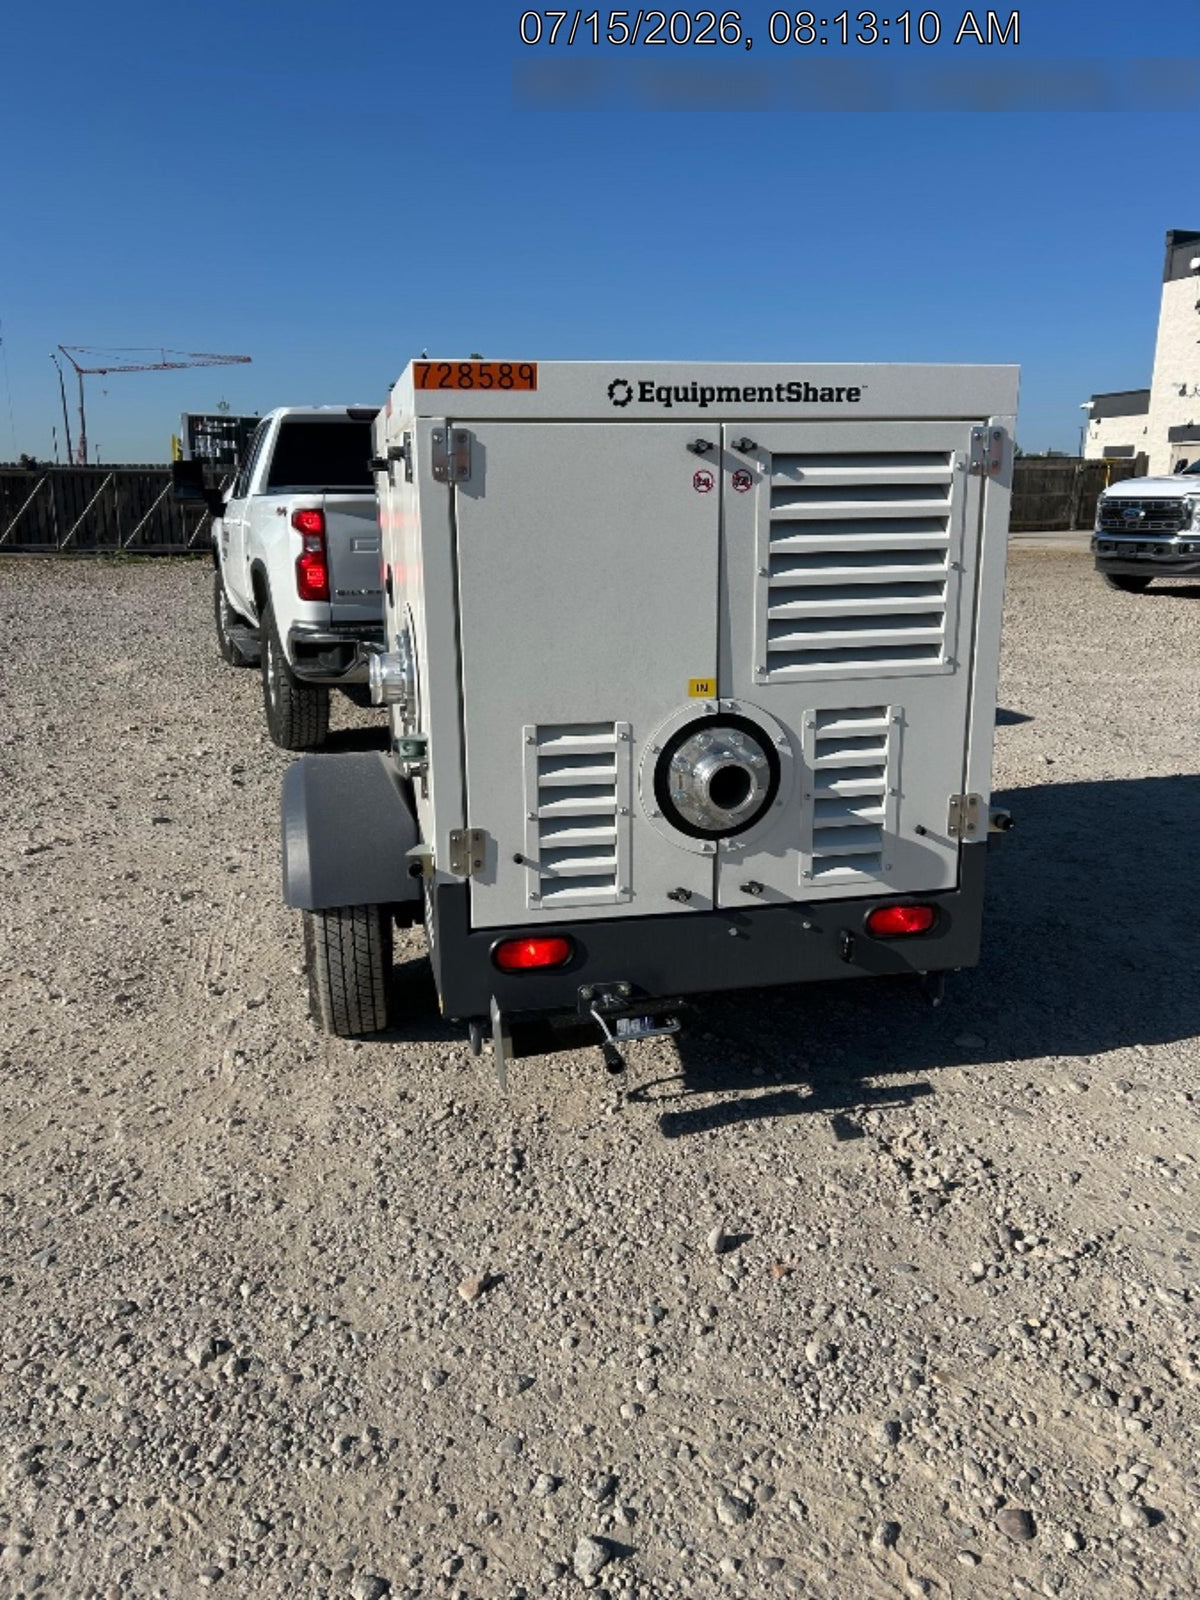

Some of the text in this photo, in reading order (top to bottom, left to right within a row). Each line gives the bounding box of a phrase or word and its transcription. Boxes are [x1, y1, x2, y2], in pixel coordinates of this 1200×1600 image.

[415, 363, 535, 390] 728589
[638, 381, 862, 408] EquipmentShare
[696, 683, 708, 692] IN
